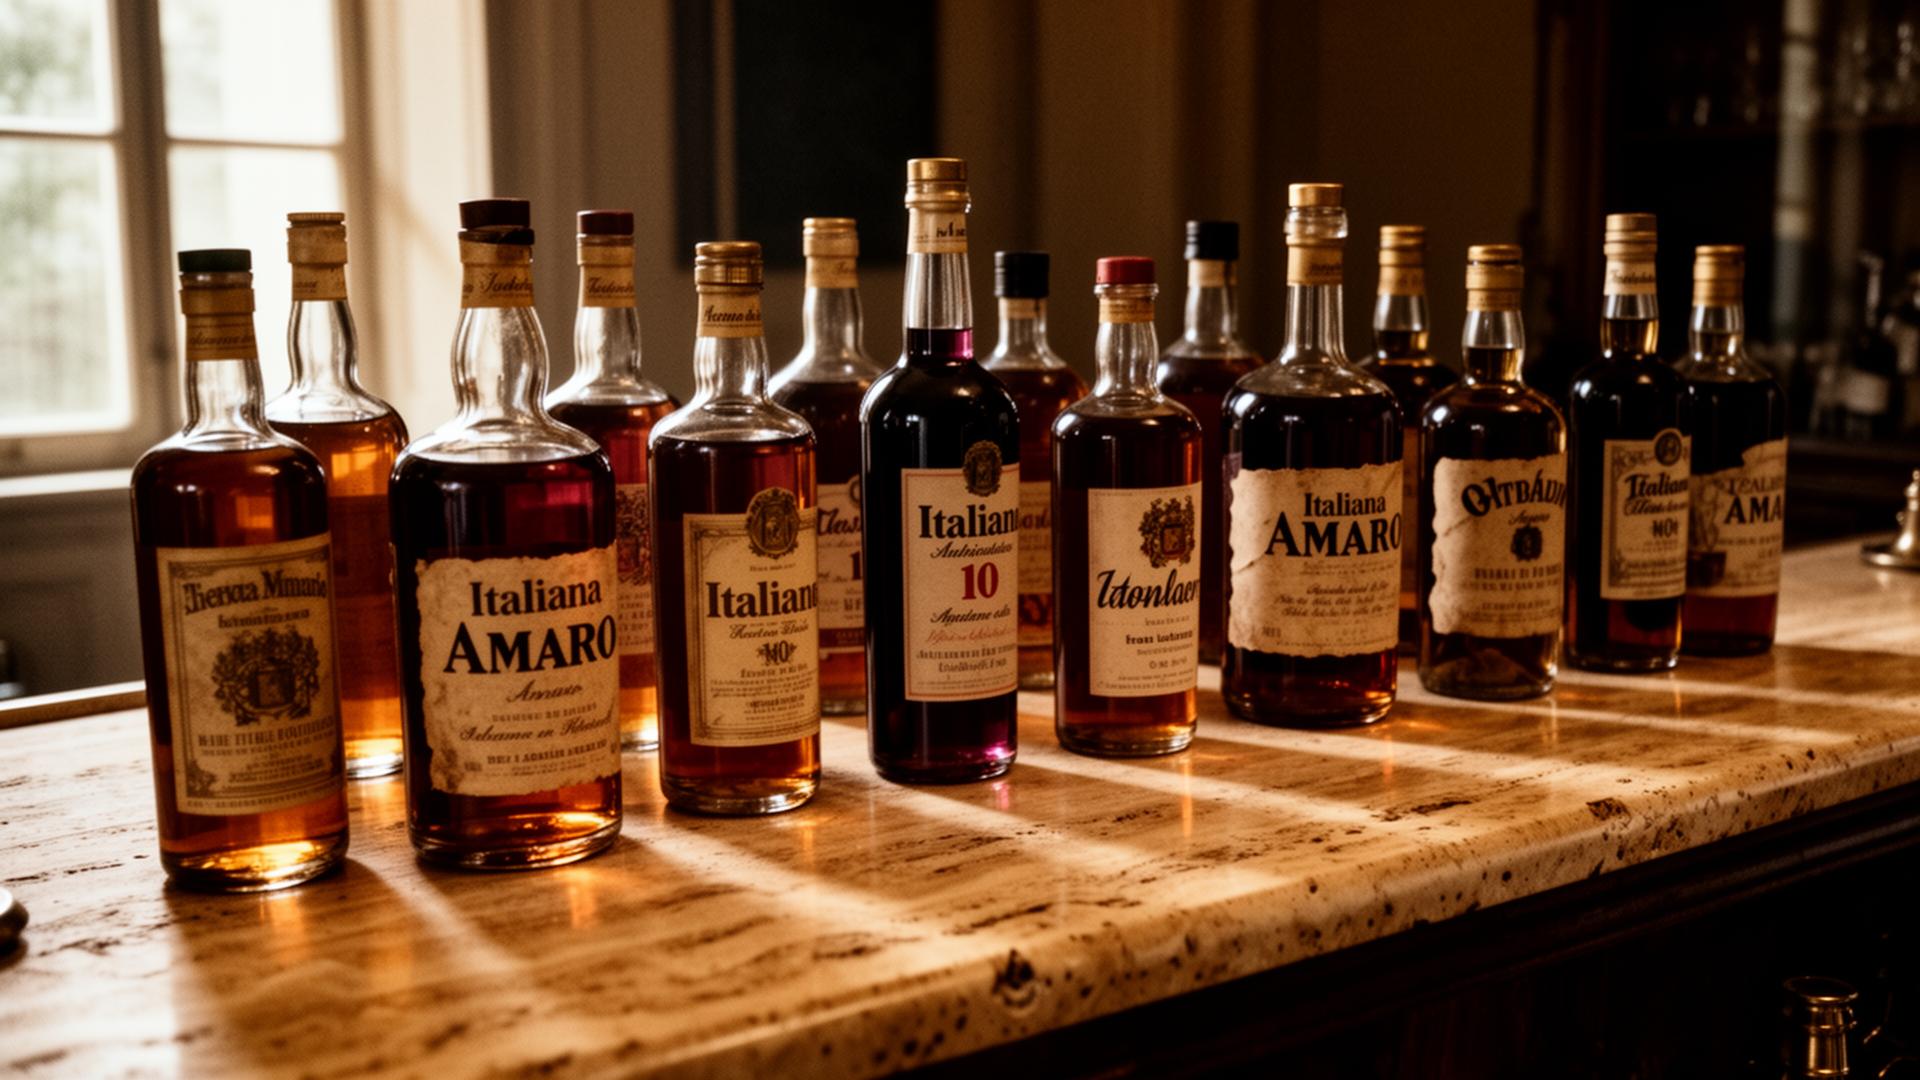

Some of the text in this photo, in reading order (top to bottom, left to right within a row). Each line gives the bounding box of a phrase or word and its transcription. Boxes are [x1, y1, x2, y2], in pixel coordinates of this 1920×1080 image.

[1304, 492, 1387, 517] Italiana
[1265, 511, 1401, 557] AMARO
[469, 579, 602, 617] Italiana
[961, 562, 999, 600] 10
[443, 615, 616, 674] AMARO
